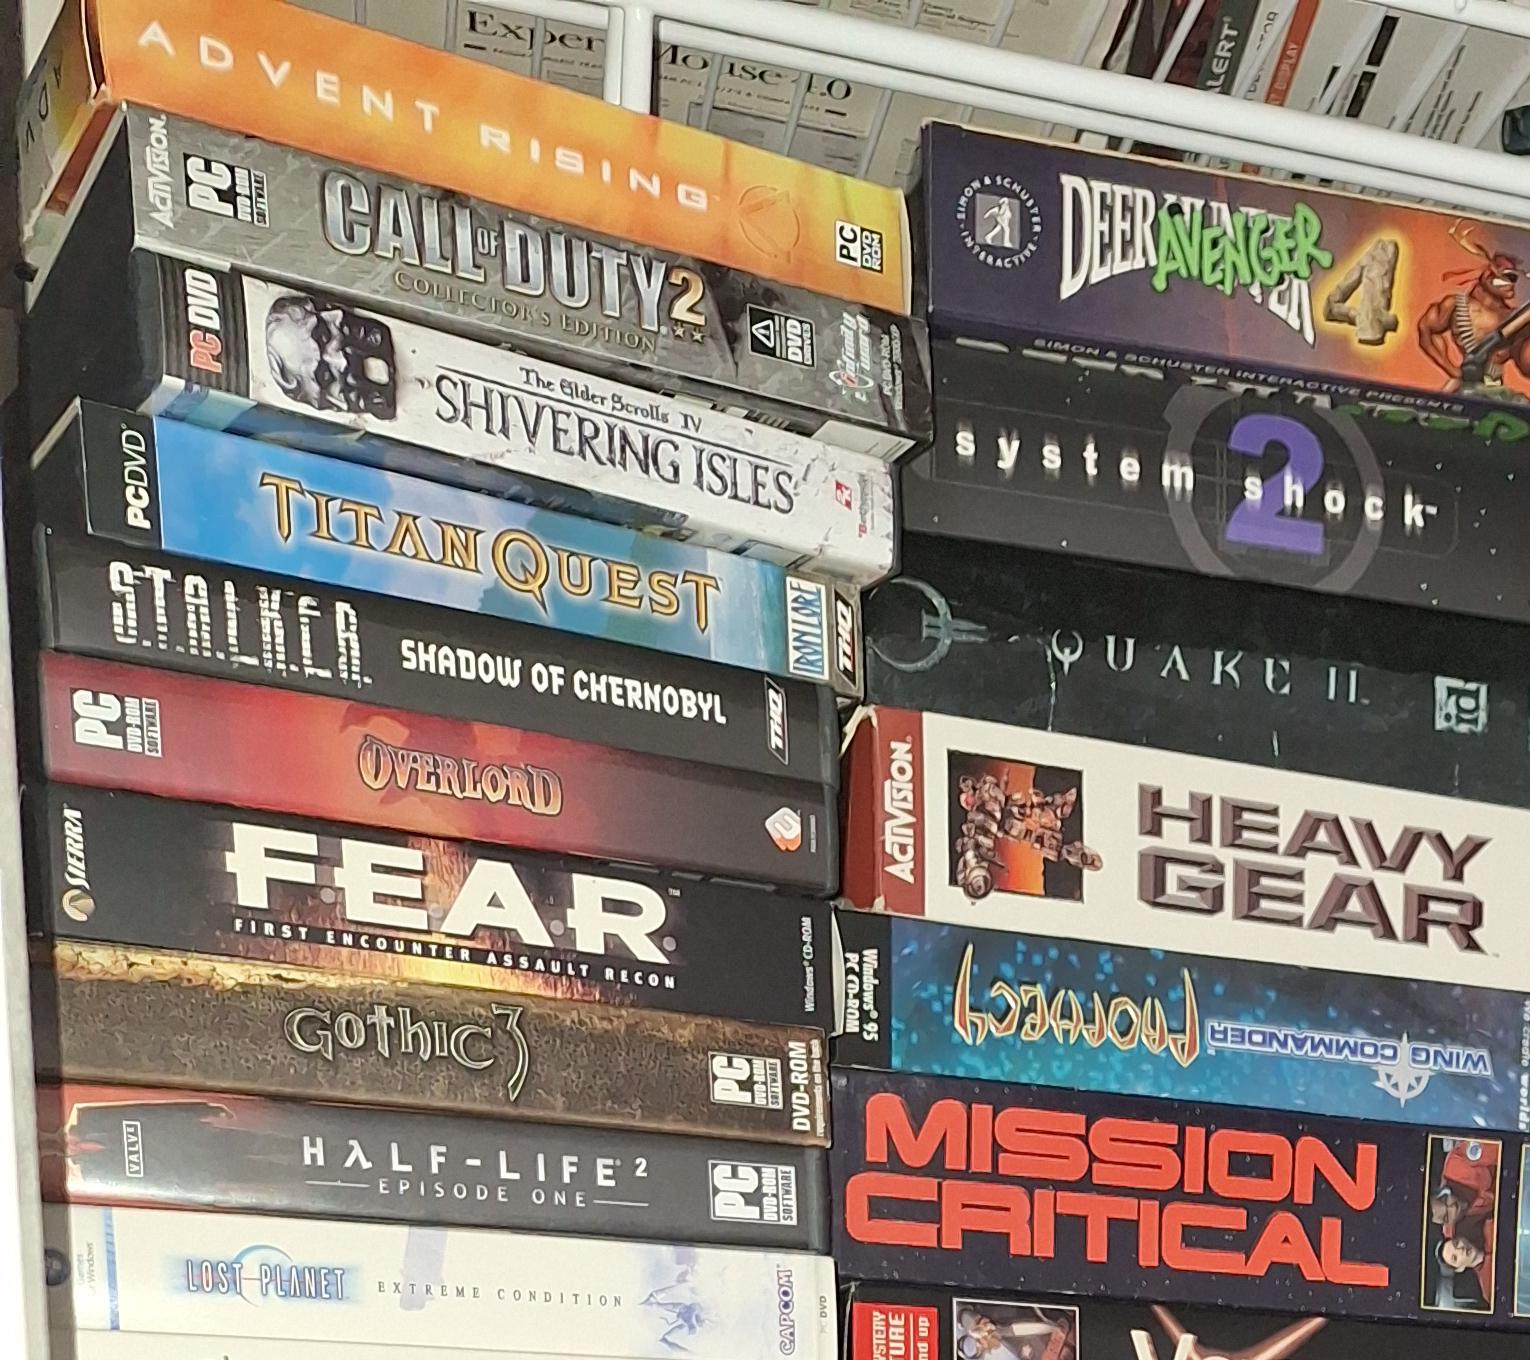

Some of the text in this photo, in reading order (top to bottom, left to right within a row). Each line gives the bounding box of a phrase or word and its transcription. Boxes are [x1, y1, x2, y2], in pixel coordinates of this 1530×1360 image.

[137, 20, 710, 212] ADVENT RISING
[322, 169, 483, 282] CALL
[501, 219, 670, 334] DUTY
[667, 267, 707, 328] 2
[1057, 171, 1401, 345] DEER AVENGER 4
[395, 270, 658, 352] COLLECTOR'S EDITION
[432, 372, 795, 516] SHIVERING ISLES
[954, 411, 1426, 556] system 2 shock
[259, 471, 721, 634] TITAN QUEST
[400, 639, 728, 726] SHADOW OF CHERNOBYL
[358, 734, 565, 817] OVERLORD
[1136, 781, 1493, 884] HEAVY
[1136, 844, 1492, 956] GEAR
[233, 918, 678, 991] FIRST ENCOUNTER ASSAULT RECON
[1208, 1021, 1493, 1077] WING COMMANDER
[378, 1176, 587, 1209] EPISODE ONE
[864, 1090, 1379, 1213] MISSION
[186, 1258, 346, 1302] LOST PLANET
[844, 1171, 1391, 1289] CRITICAL
[376, 1280, 624, 1308] EXTREME CONDITION
[776, 1268, 794, 1356] CAPCOM
